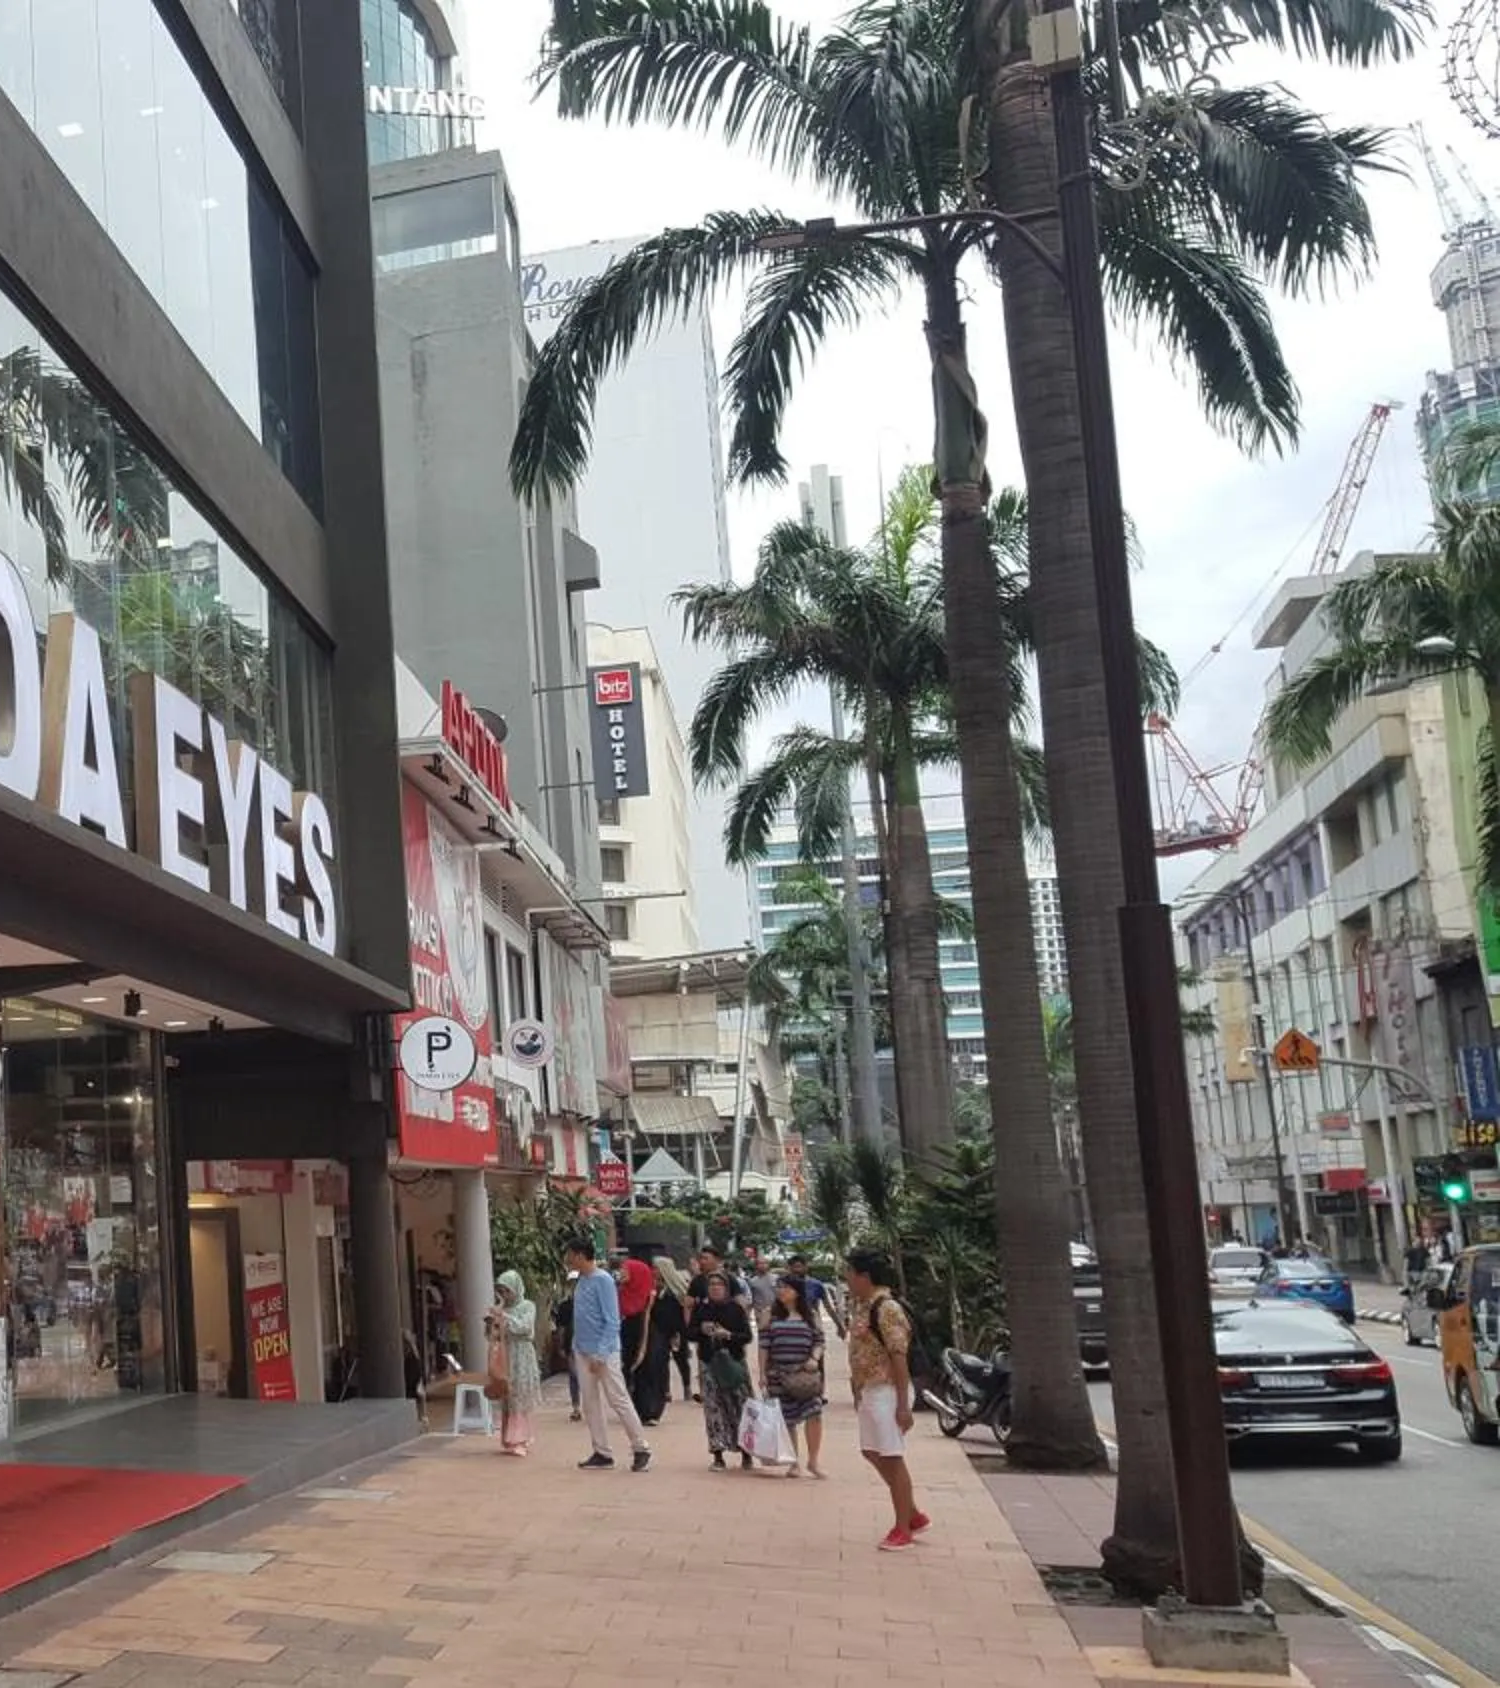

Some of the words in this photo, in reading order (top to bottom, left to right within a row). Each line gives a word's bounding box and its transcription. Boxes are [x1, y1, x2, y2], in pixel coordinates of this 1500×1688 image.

[609, 709, 628, 789] HOTEL
[155, 672, 337, 957] EYES
[250, 1298, 267, 1319] WE
[253, 1330, 289, 1363] OPEN
